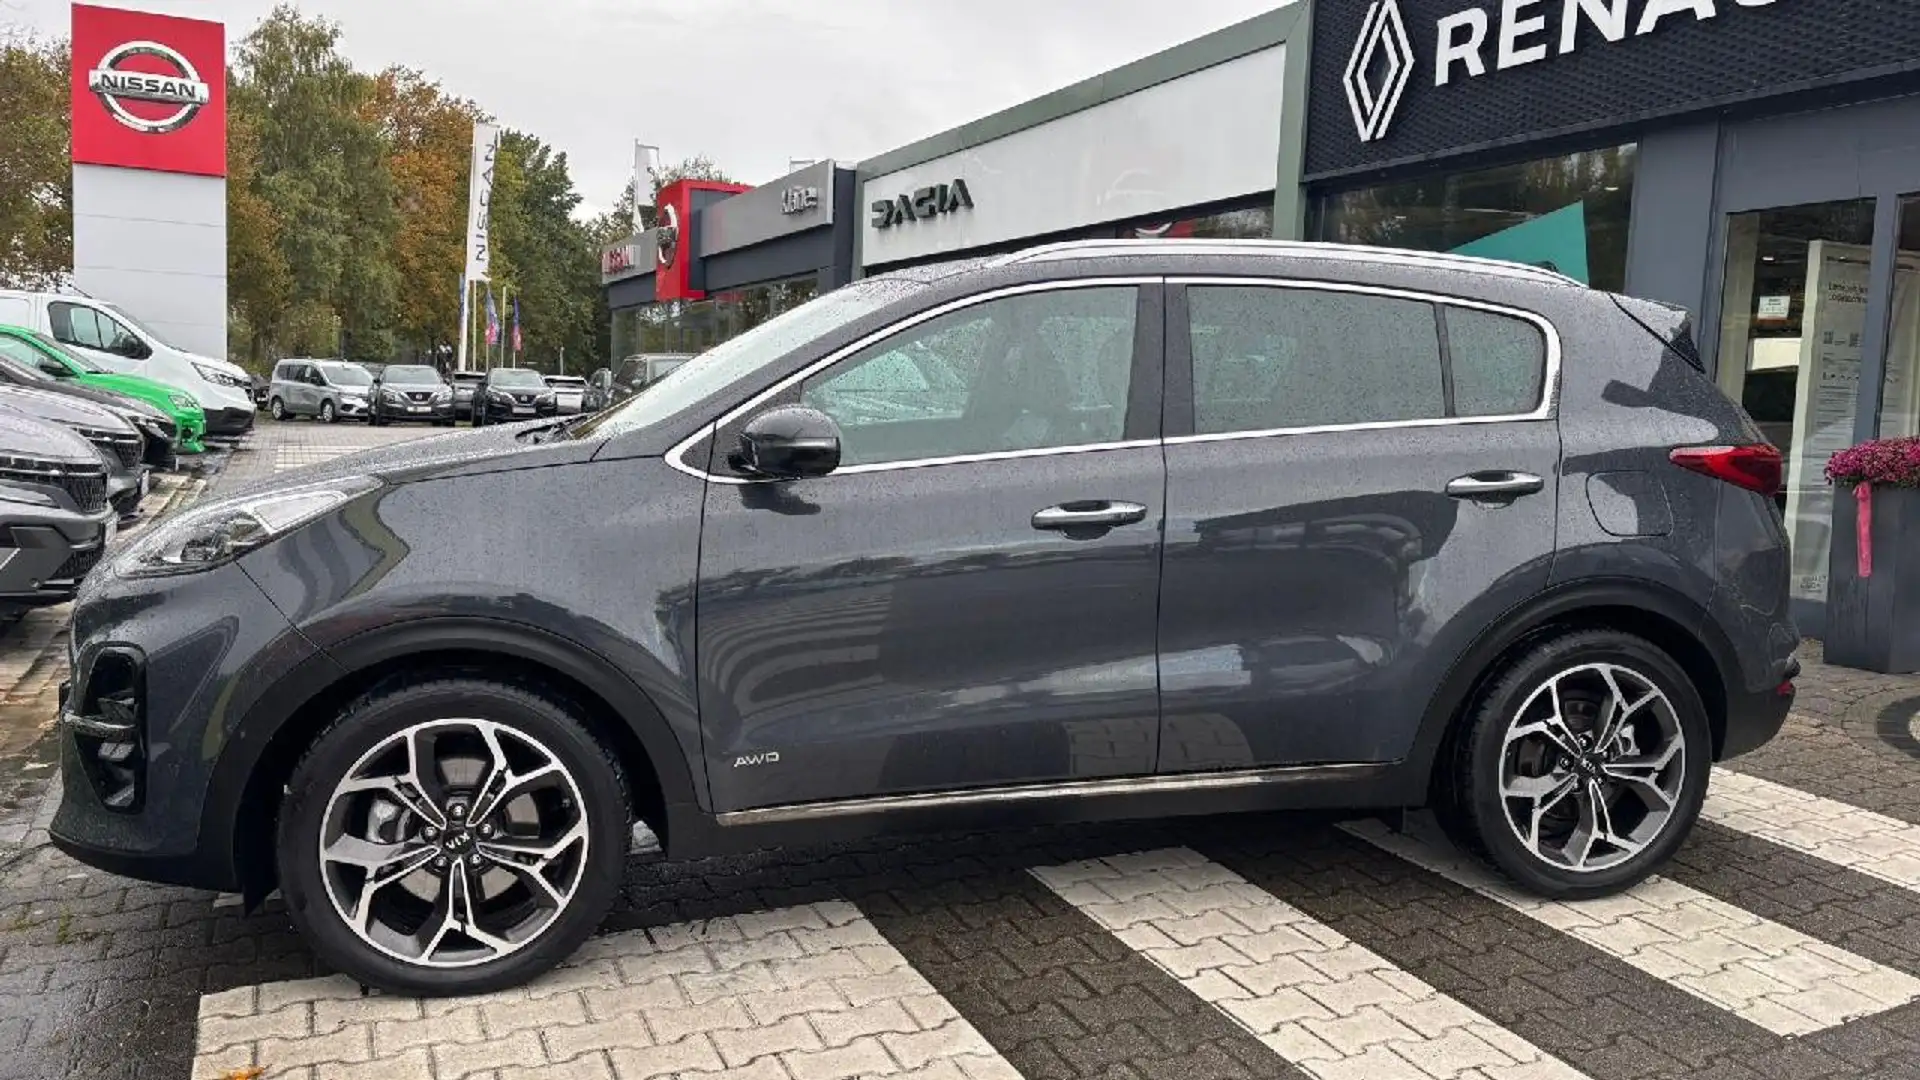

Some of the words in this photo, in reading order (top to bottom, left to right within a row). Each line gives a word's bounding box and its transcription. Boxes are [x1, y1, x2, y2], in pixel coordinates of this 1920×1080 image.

[101, 74, 196, 97] NISSAN
[871, 178, 974, 228] DACIA
[733, 751, 780, 768] AWD
